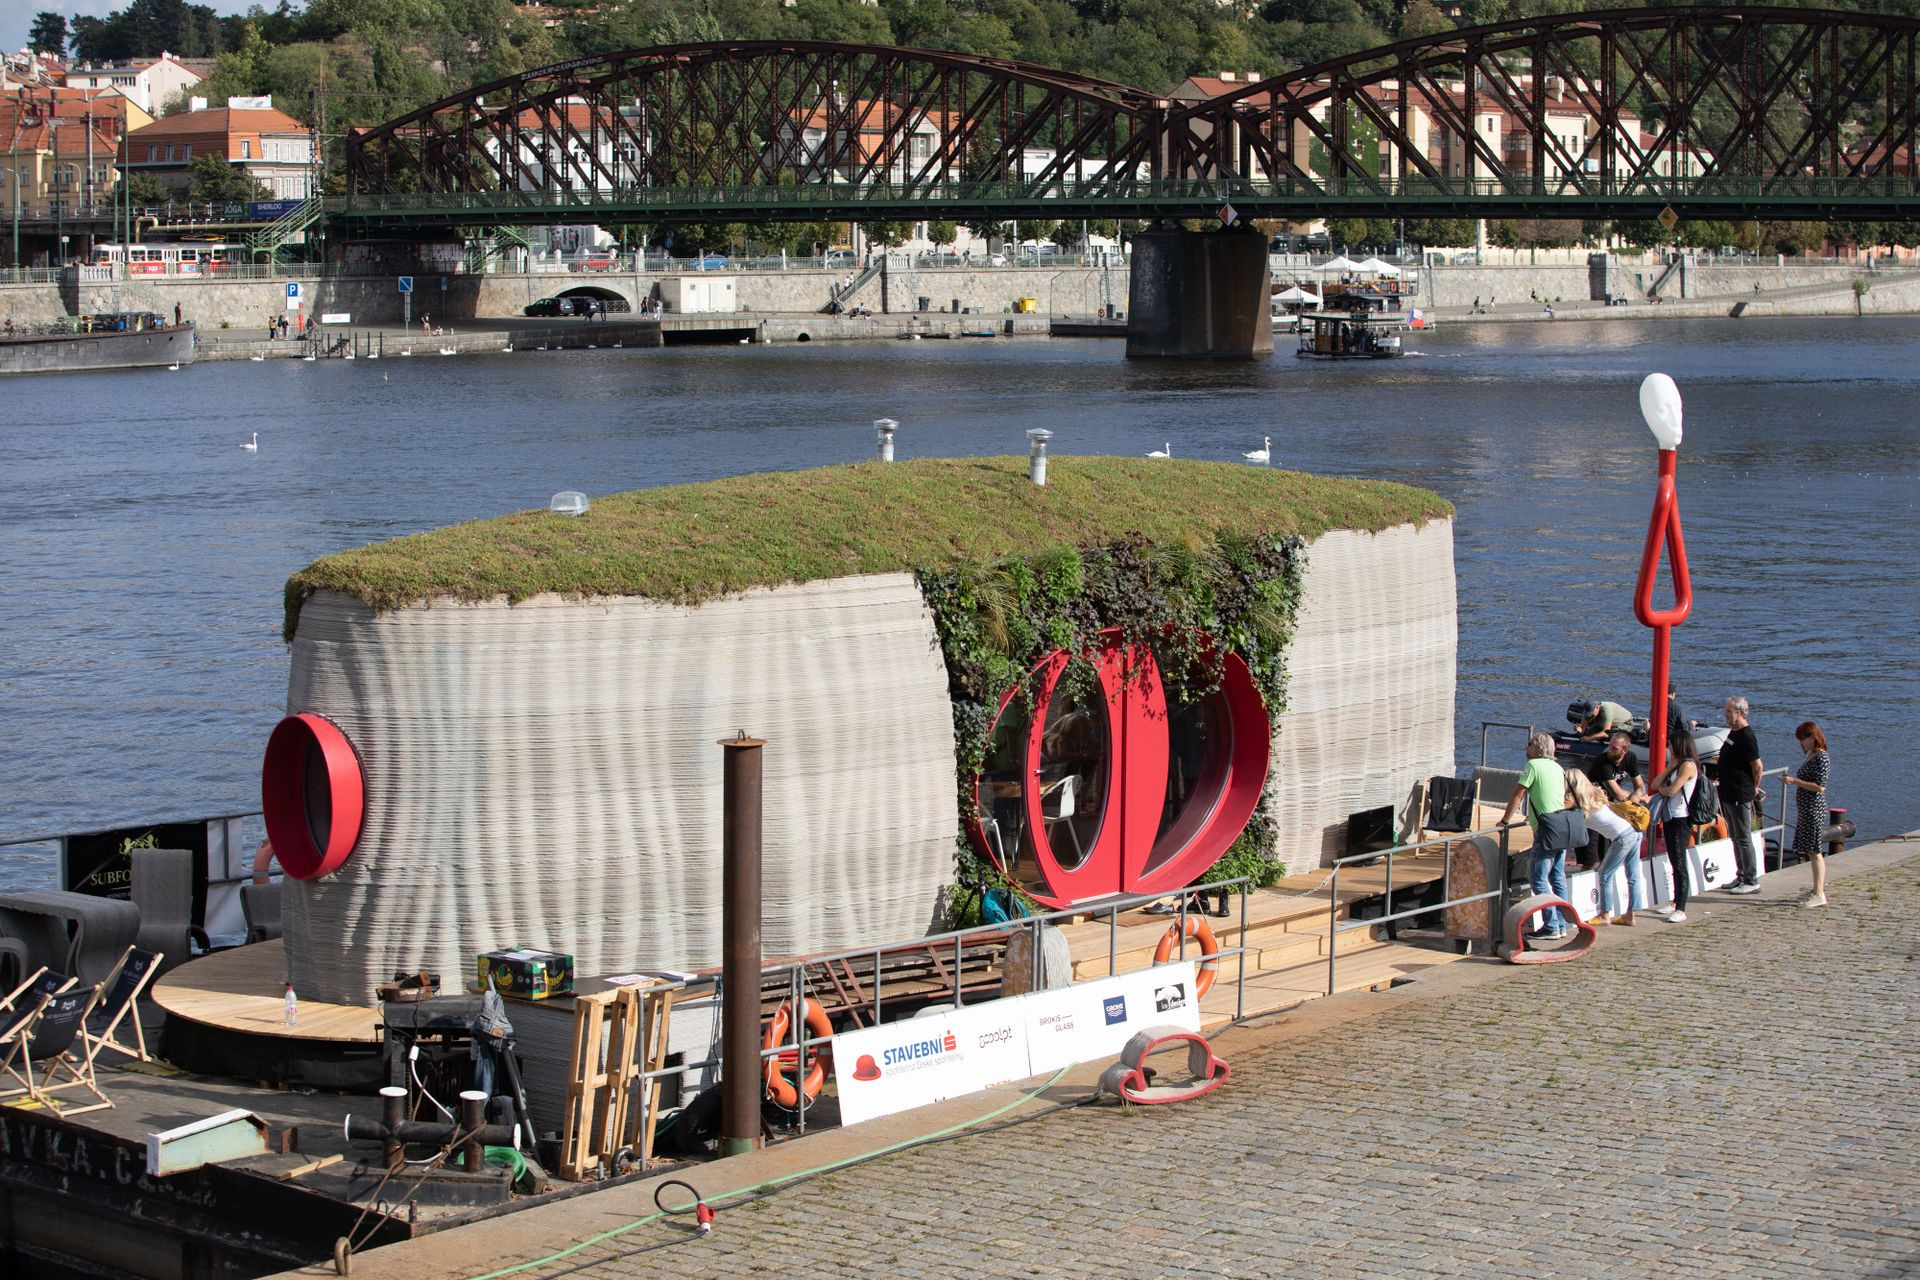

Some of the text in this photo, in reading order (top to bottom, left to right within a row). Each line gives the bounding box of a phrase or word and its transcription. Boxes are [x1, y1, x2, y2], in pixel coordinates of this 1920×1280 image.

[290, 285, 297, 296] P
[89, 869, 132, 886] SUBFO
[1055, 1020, 1074, 1032] GLASS
[883, 1034, 943, 1066] STAVEBNÍ
